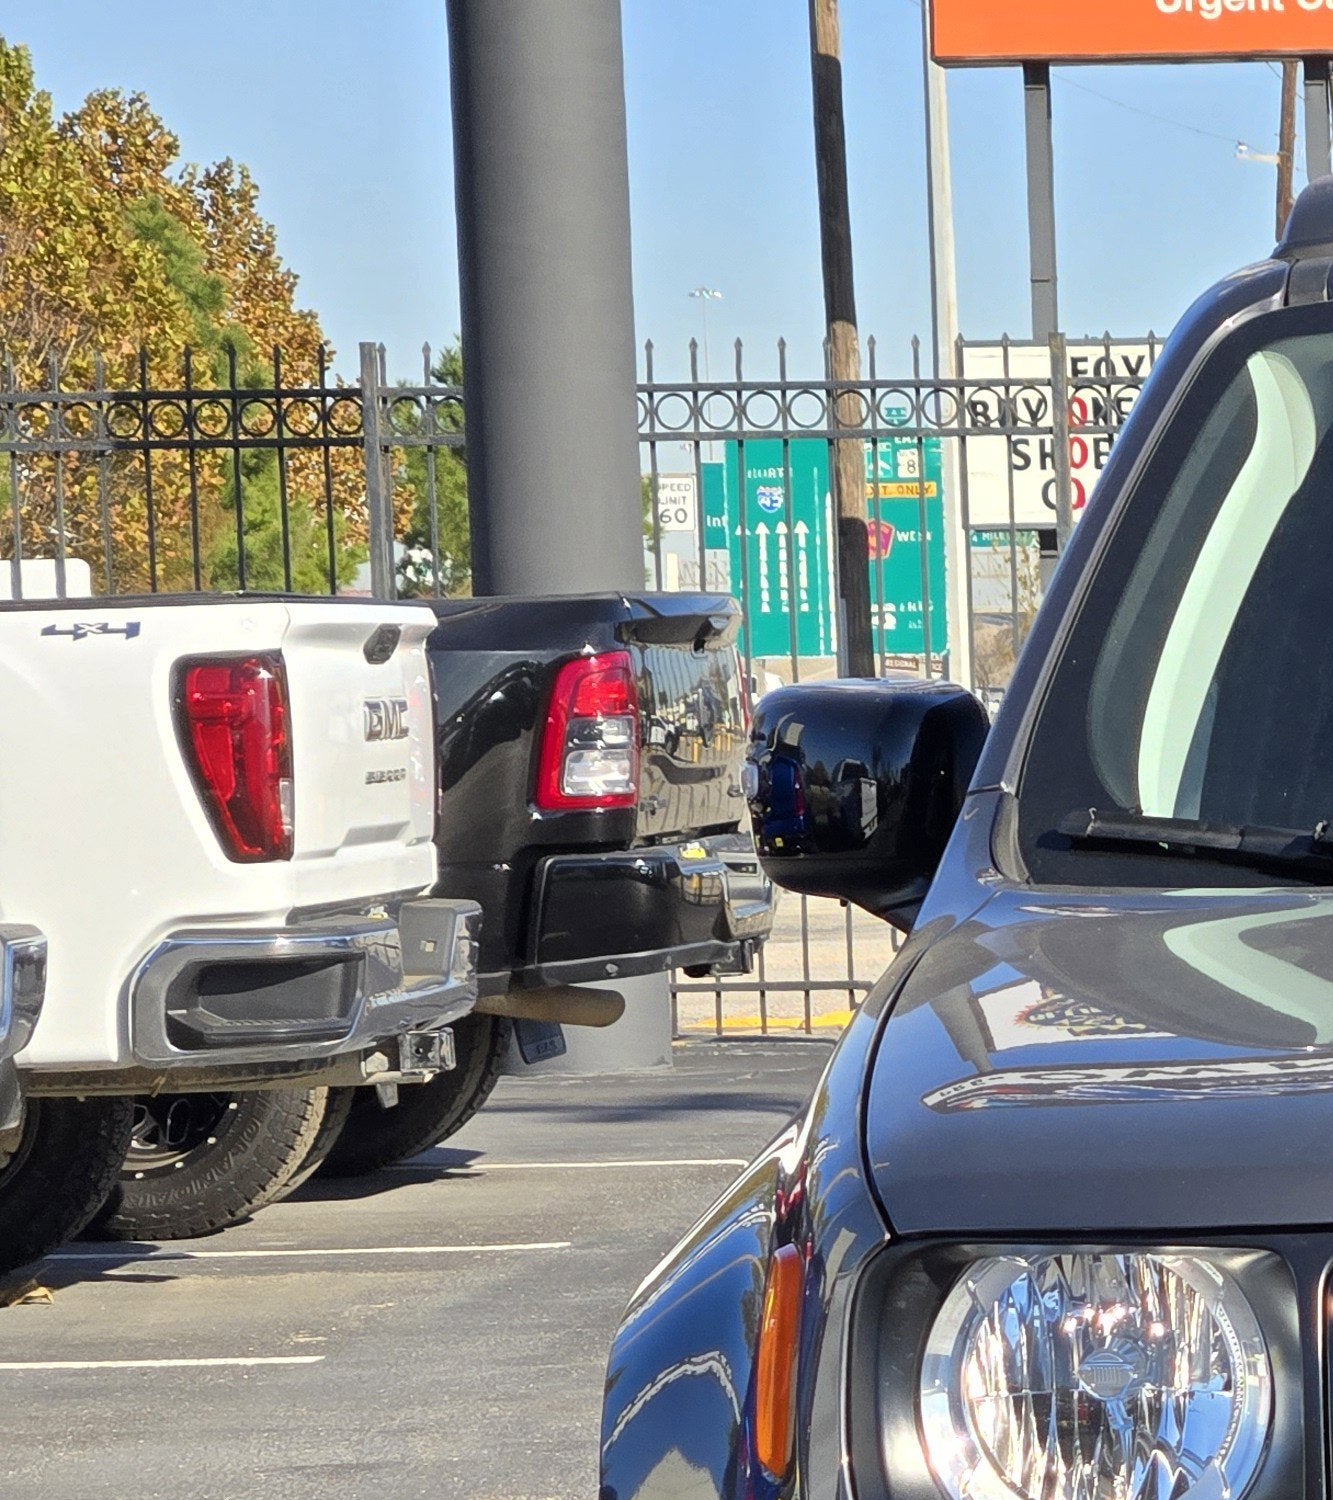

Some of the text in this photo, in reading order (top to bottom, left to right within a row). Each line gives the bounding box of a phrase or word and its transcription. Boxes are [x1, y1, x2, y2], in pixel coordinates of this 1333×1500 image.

[658, 483, 692, 491] PEED
[659, 508, 688, 524] 60
[363, 699, 409, 742] GMC
